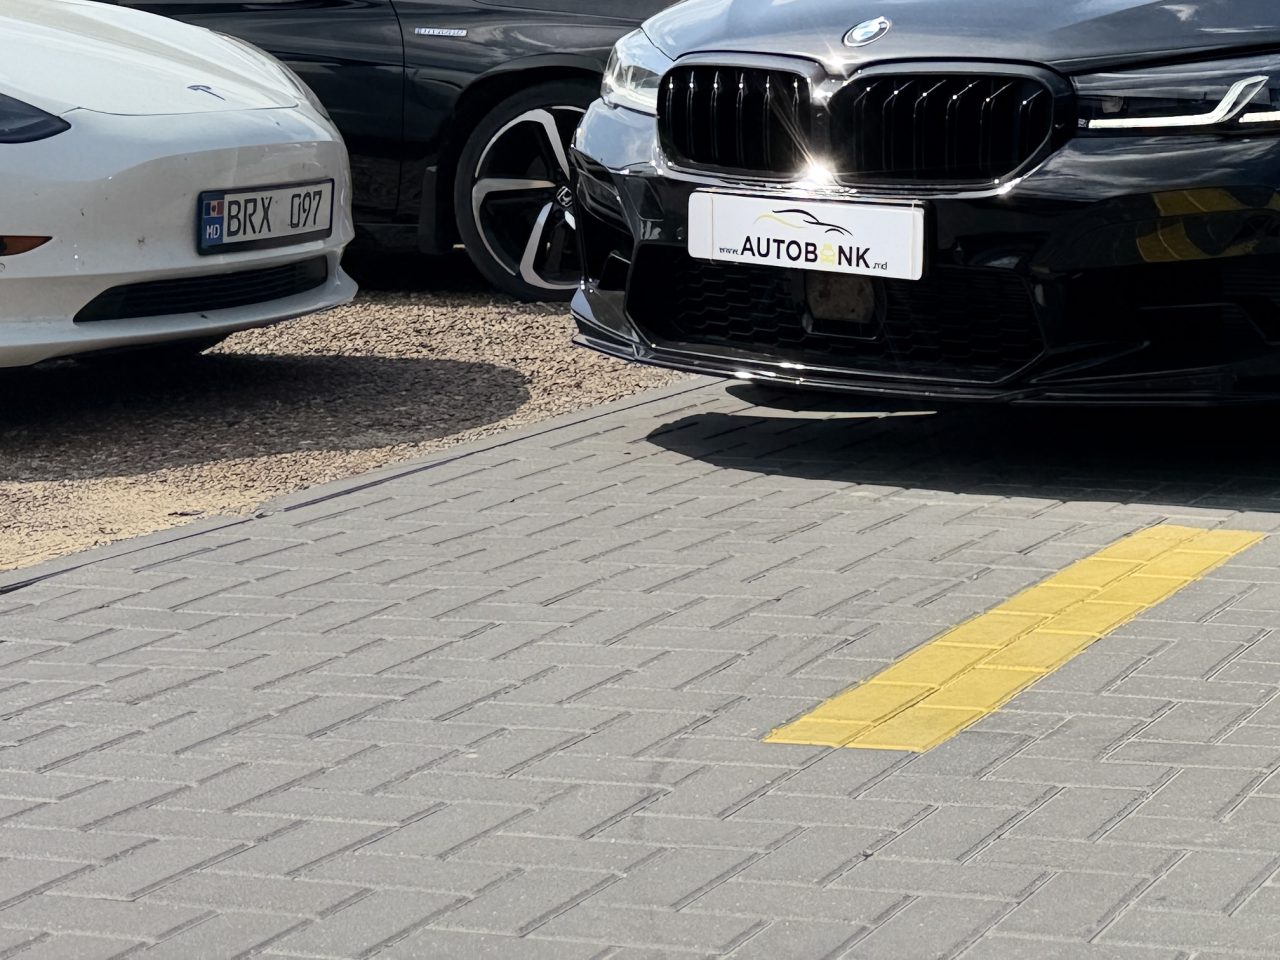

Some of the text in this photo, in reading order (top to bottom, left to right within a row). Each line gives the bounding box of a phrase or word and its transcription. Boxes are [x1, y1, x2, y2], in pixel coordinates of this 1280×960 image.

[226, 190, 323, 238] BRX 097
[206, 223, 221, 239] MD
